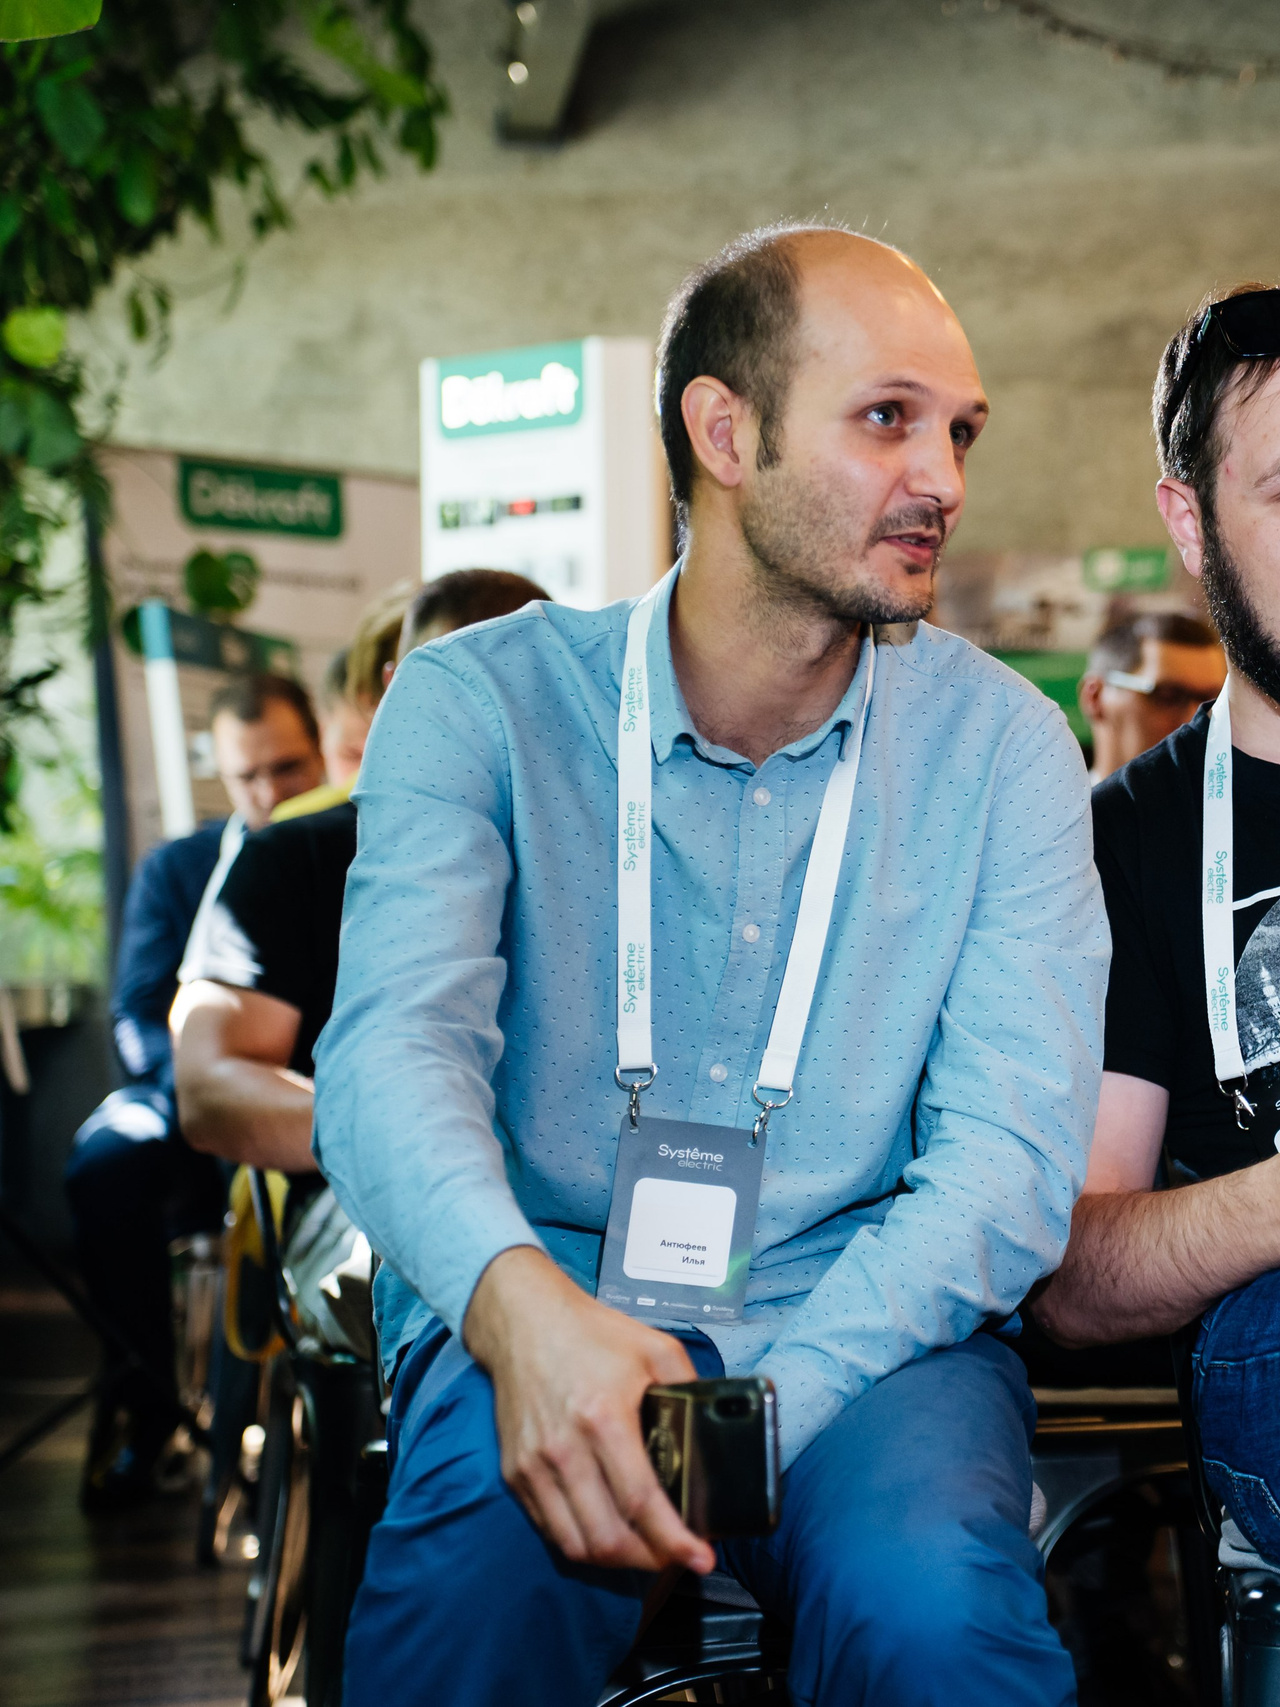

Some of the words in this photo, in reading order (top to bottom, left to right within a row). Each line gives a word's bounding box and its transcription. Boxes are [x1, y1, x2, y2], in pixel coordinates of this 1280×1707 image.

[623, 667, 638, 732] Systême
[1214, 752, 1228, 799] Systême
[622, 801, 639, 871] Systême
[637, 801, 646, 849] electric
[1206, 867, 1214, 904] electric
[1213, 850, 1228, 904] Systême
[622, 943, 639, 1014] Systême
[637, 943, 646, 991] electric
[1210, 988, 1220, 1032] electric
[1217, 966, 1229, 1032] Systême
[658, 1143, 724, 1163] Systême
[677, 1158, 723, 1172] electric
[660, 1239, 707, 1252] Антюфеев
[682, 1255, 706, 1266] Илья
